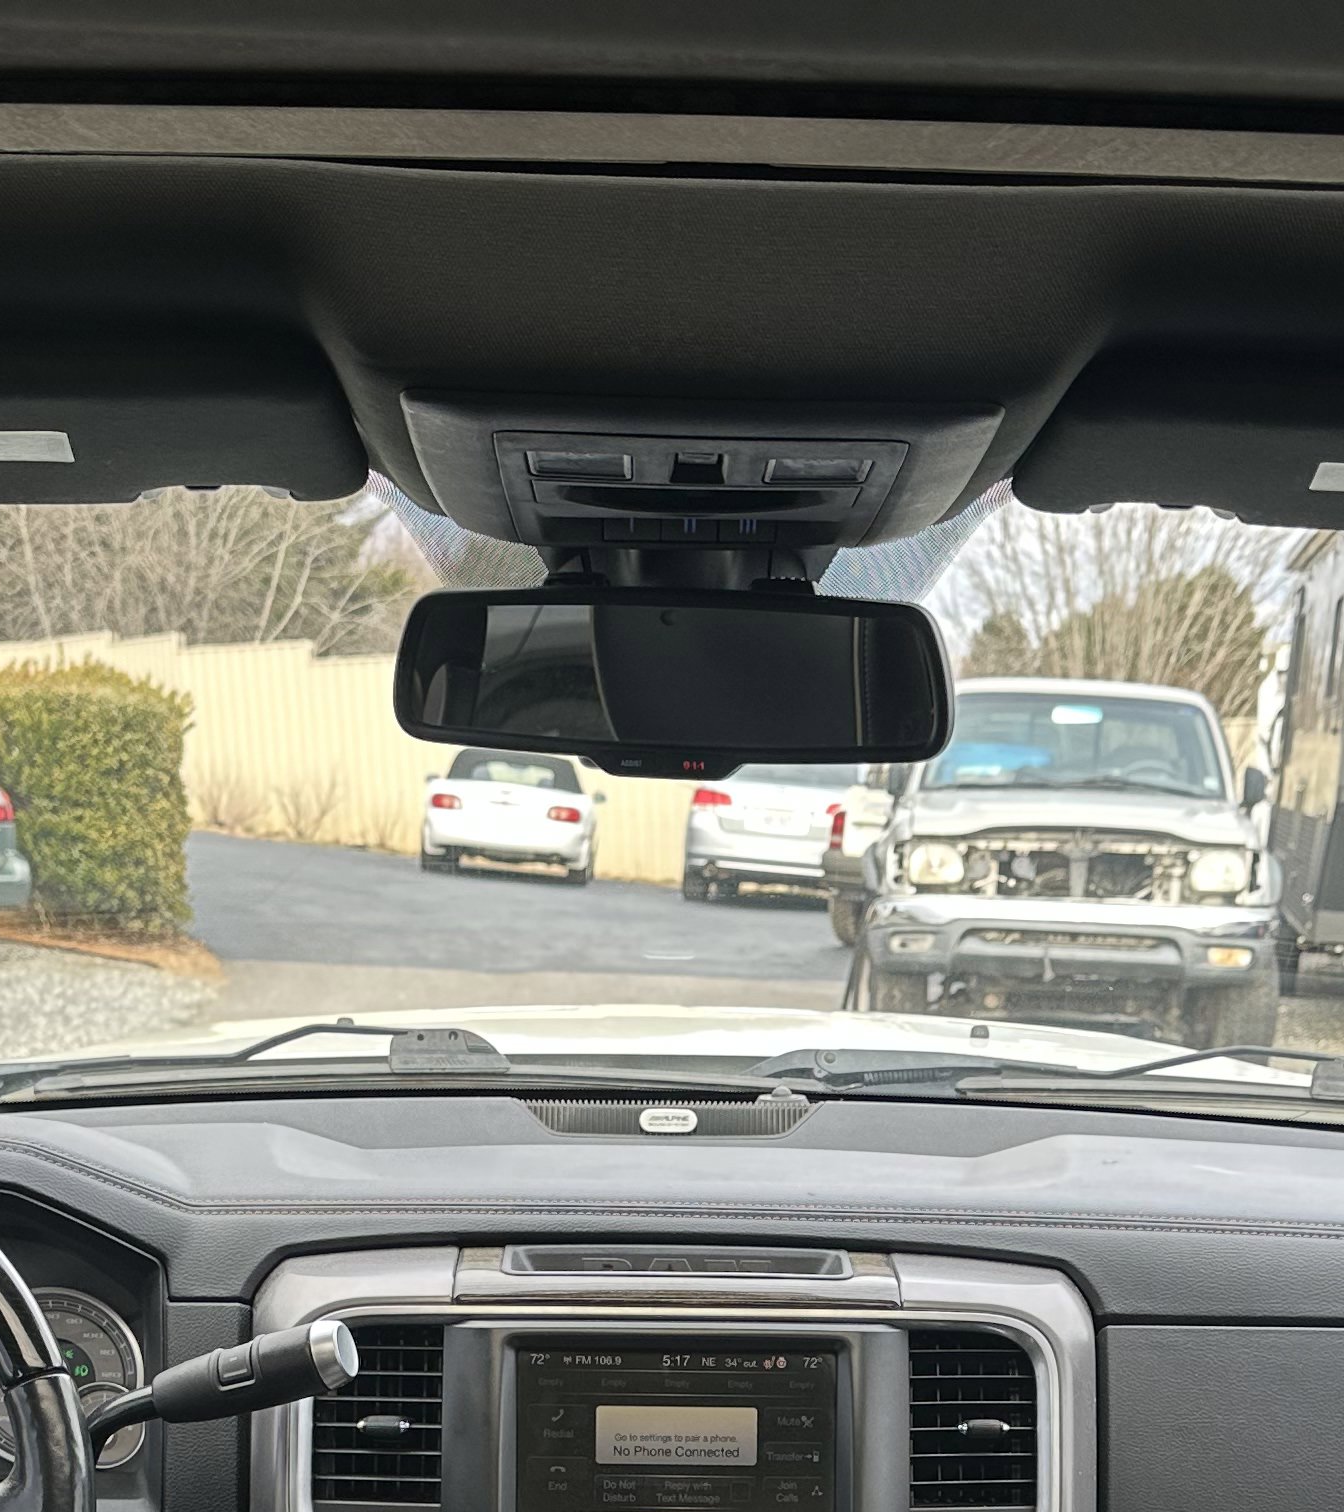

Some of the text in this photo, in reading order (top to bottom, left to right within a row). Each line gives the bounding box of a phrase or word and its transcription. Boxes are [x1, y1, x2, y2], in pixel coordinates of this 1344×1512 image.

[575, 1355, 592, 1365] FM
[662, 1354, 691, 1367] 5:17
[701, 1357, 717, 1367] NE
[614, 1433, 628, 1442] Go
[629, 1434, 638, 1442] to
[639, 1434, 673, 1444] settings
[685, 1435, 701, 1444] pair
[613, 1445, 740, 1458] No Phone Connected
[548, 1480, 568, 1491] End
[603, 1480, 636, 1490] Do Not
[656, 1493, 677, 1503] Text
